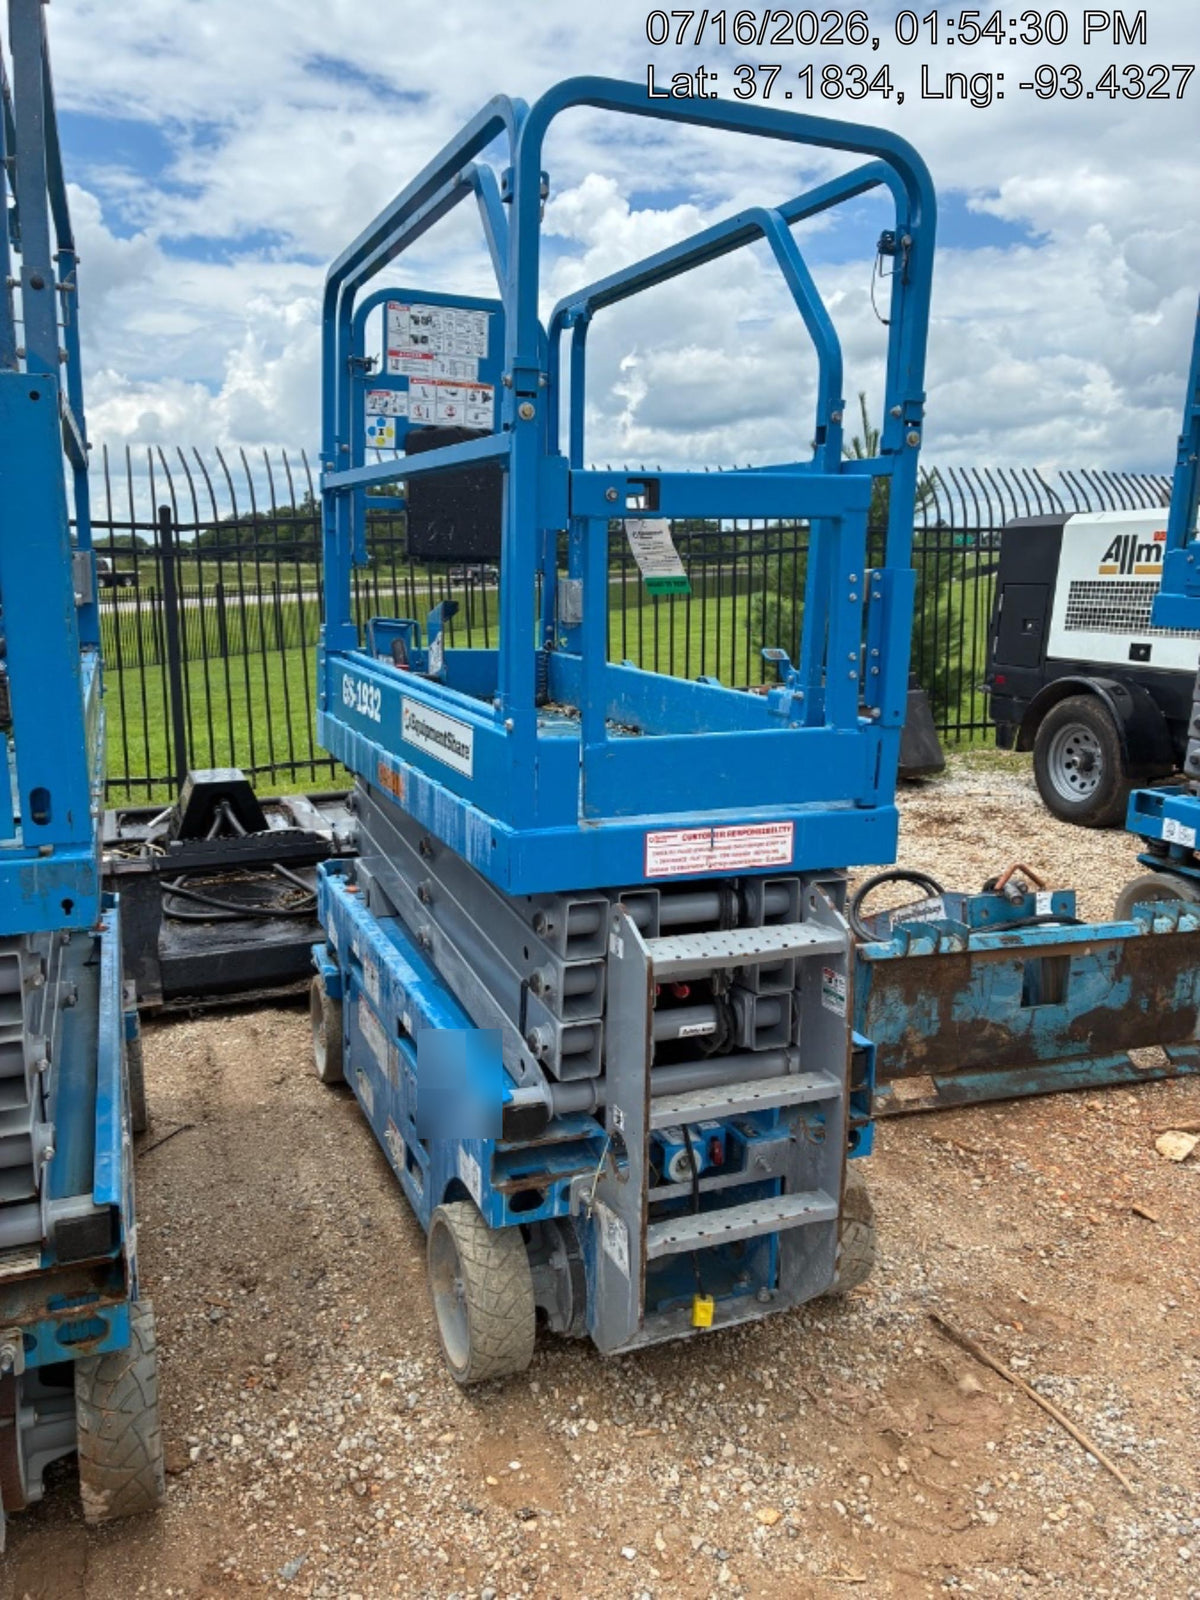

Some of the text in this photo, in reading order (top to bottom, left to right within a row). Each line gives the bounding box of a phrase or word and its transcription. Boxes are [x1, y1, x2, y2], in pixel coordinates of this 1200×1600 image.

[343, 673, 381, 723] GS-1932
[409, 712, 470, 760] EquipmentShare
[727, 826, 791, 838] RESPONSIBILITY
